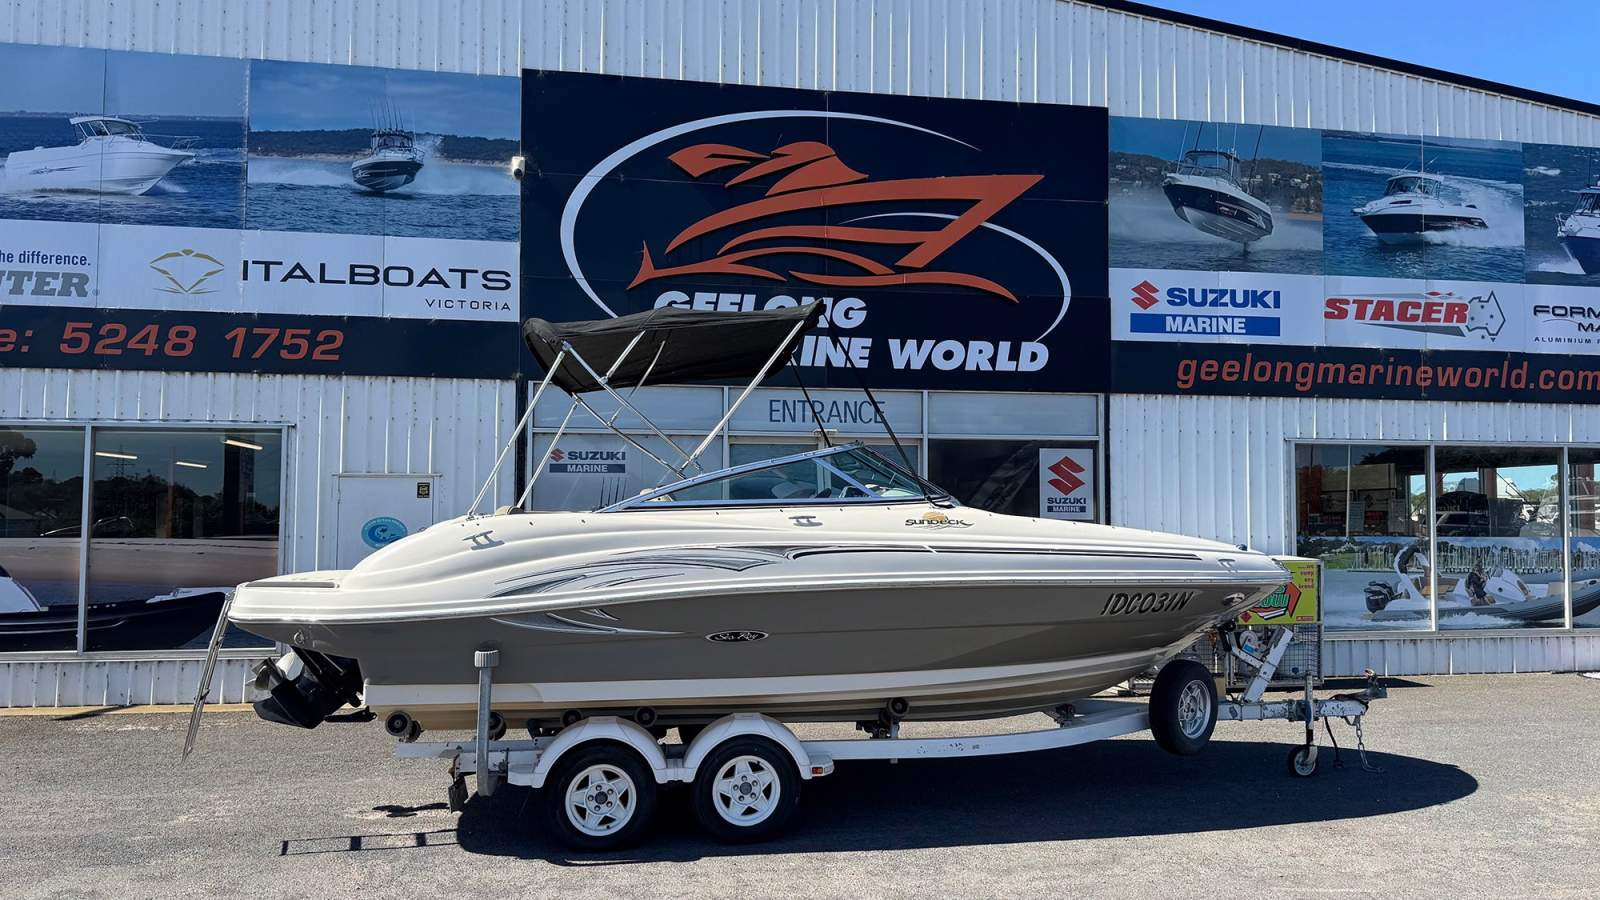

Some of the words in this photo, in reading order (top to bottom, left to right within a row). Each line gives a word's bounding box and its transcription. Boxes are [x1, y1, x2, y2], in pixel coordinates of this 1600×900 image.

[19, 251, 91, 266] difference.
[0, 270, 90, 298] TER
[242, 260, 512, 291] ITALBOATS
[425, 298, 511, 312] VICTORIA
[1166, 287, 1281, 309] SUZUKI
[1324, 297, 1469, 324] STACER
[1165, 315, 1246, 334] MARINE
[60, 322, 197, 358] 5248
[224, 326, 345, 361] 1752
[1534, 336, 1592, 344] ALUMINIUM
[888, 338, 1049, 373] WORLD
[1176, 352, 1600, 392] geelongmarineworld.com
[768, 399, 886, 424] ENTRANCE
[567, 451, 626, 461] SUZUKI
[567, 464, 609, 473] MARINE
[1047, 497, 1087, 505] SUZUKI
